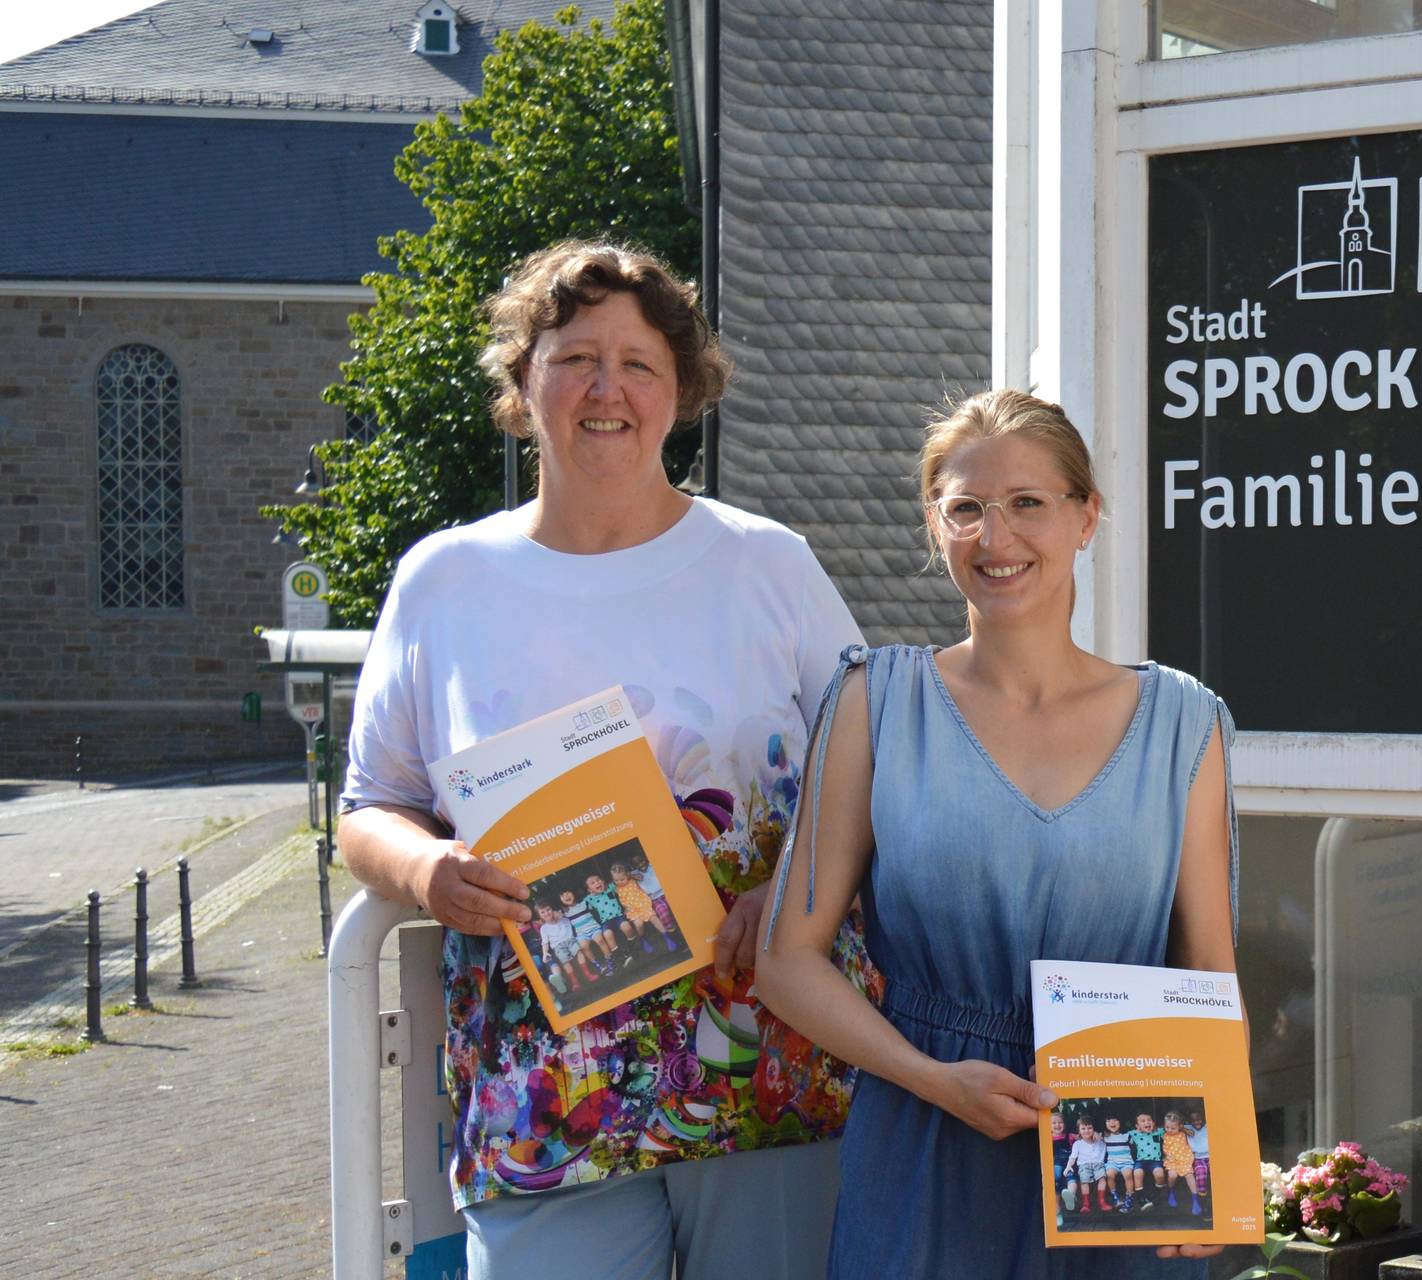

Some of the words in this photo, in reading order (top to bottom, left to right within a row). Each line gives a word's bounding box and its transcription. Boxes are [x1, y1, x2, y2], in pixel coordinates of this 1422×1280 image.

[1165, 298, 1267, 344] Stadt
[300, 577, 312, 592] H
[560, 733, 577, 743] Stadt
[562, 719, 631, 752] SPROCKHÖVEL
[477, 758, 533, 788] kinderstark
[483, 800, 617, 864] Familienwegweiser
[583, 820, 634, 848] Unterstützung
[1071, 989, 1129, 1001] kinderstark
[1163, 995, 1233, 1008] SPROCKHÖVEL
[1048, 1055, 1194, 1070] Familienwegweiser
[1049, 1079, 1075, 1088] Geburt
[1081, 1079, 1145, 1088] Kinderbetreuung
[1150, 1079, 1204, 1088] Unterstützung
